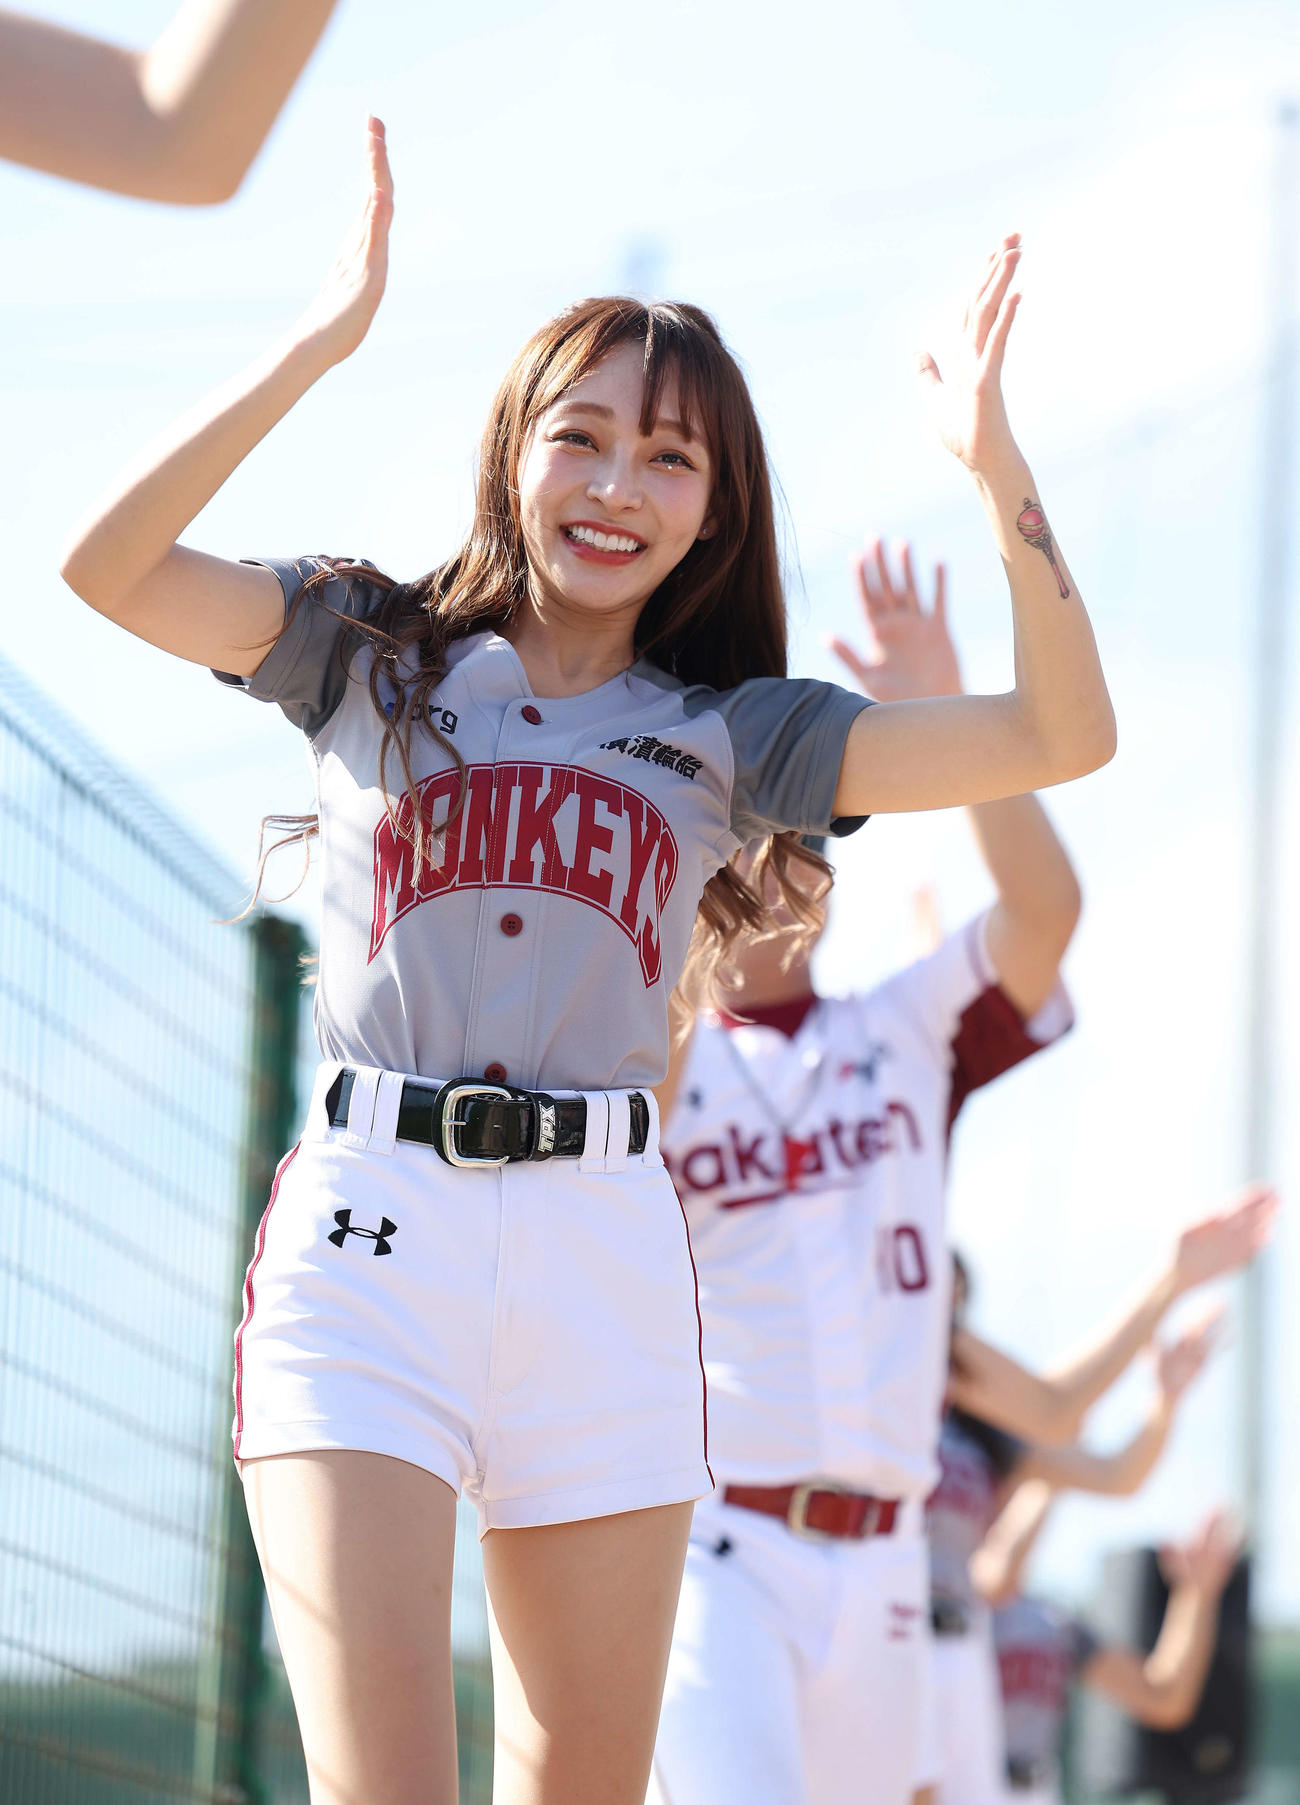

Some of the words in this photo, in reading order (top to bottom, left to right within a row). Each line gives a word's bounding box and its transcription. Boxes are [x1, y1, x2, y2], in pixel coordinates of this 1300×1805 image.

[367, 761, 679, 989] MONKEYS
[537, 1102, 556, 1152] TPX
[661, 1097, 922, 1200] akuten
